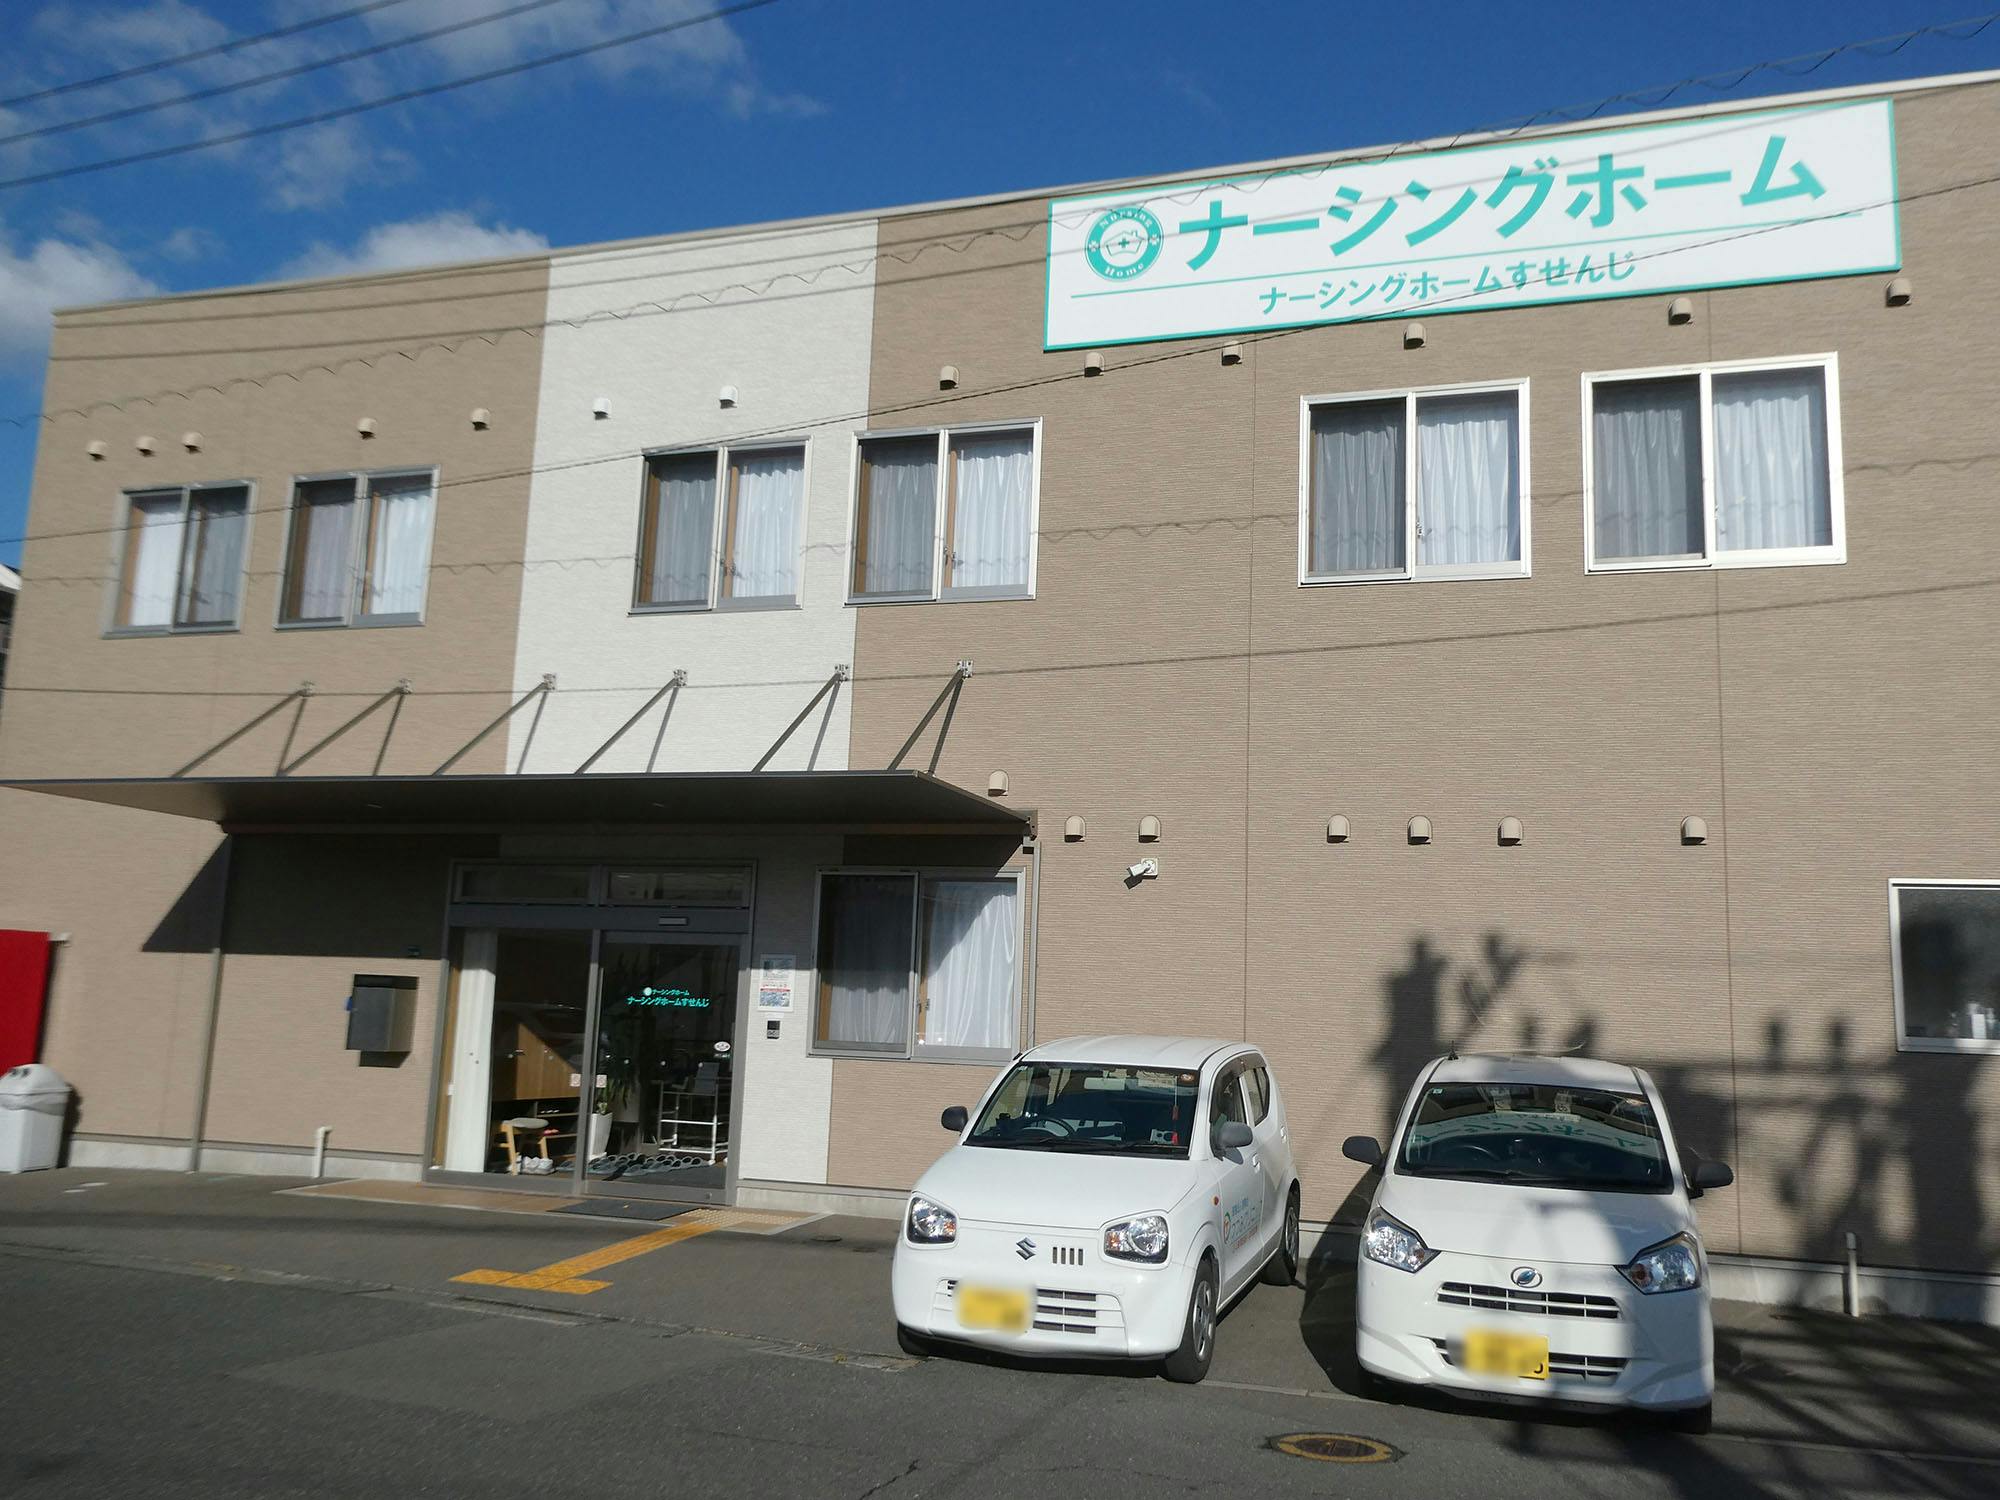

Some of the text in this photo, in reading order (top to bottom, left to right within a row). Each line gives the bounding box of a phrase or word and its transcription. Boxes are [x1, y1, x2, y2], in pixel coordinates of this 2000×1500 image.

[1179, 136, 1824, 270] ナーシングホーム
[1104, 263, 1144, 278] Home
[1260, 253, 1636, 314] ナーシングホームすせんじ
[627, 995, 710, 1008] ナーシングホームすせんじ
